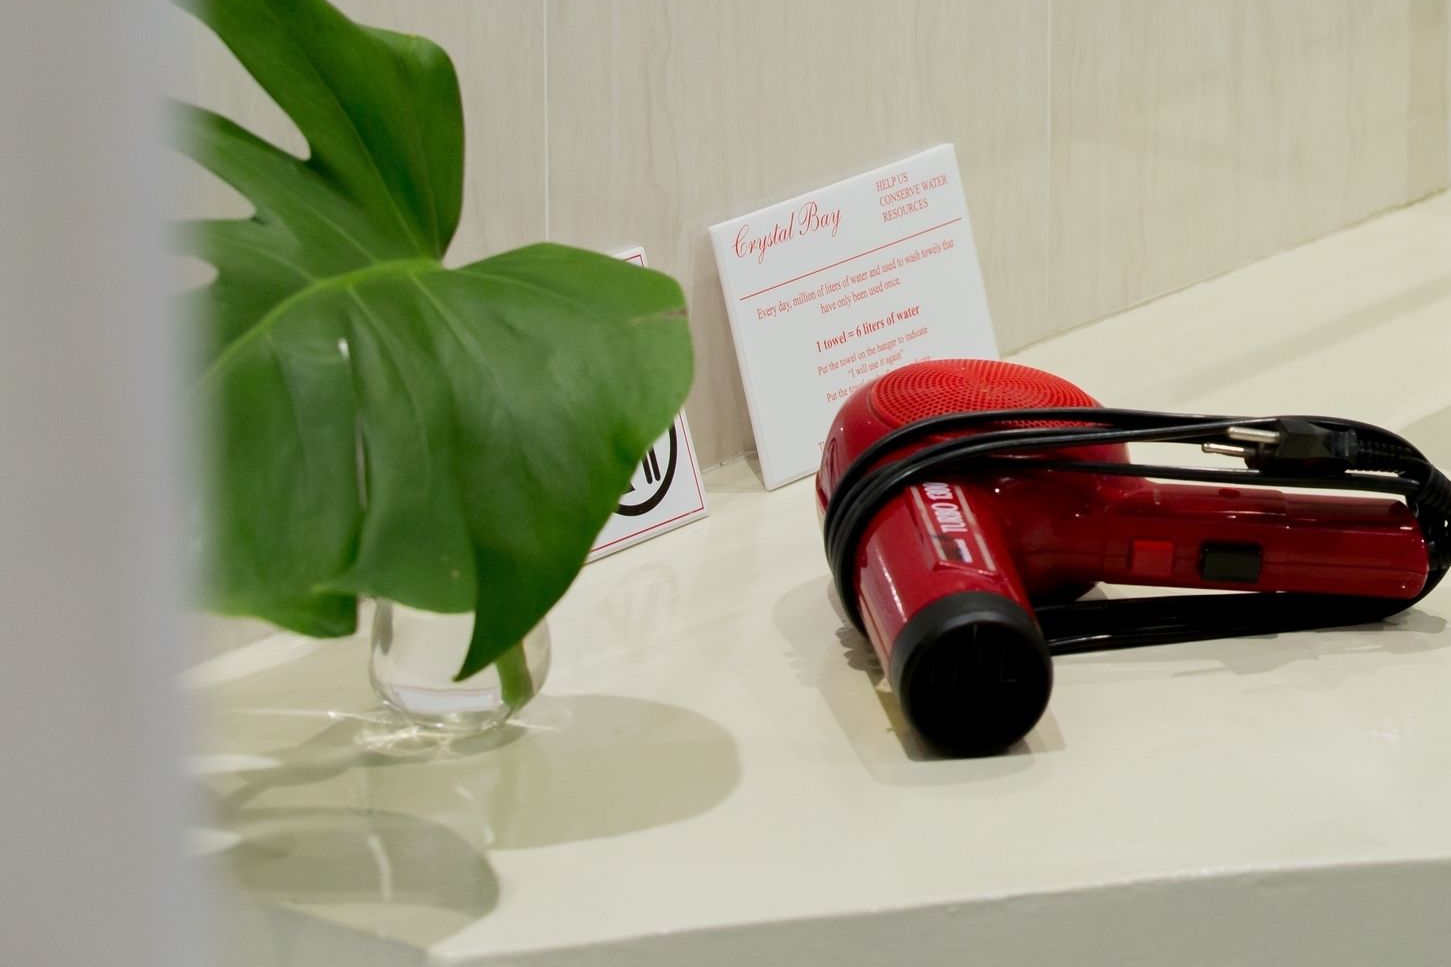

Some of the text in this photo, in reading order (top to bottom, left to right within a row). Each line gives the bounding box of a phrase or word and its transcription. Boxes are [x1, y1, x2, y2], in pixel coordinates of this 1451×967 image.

[876, 172, 908, 192] HELP US
[880, 175, 948, 207] CONSERVE WATER
[882, 198, 928, 223] RESOURCES
[732, 200, 841, 264] Crystal Bay
[757, 306, 777, 320] Every
[793, 290, 816, 307] million
[817, 284, 825, 297] of
[842, 275, 850, 288] of
[850, 271, 868, 284] water
[869, 264, 881, 278] and
[881, 258, 897, 273] used
[897, 258, 904, 268] to
[905, 250, 921, 264] wash
[820, 302, 836, 314] have
[837, 294, 851, 308] only
[852, 289, 867, 303] been
[868, 281, 883, 296] used
[816, 305, 920, 353] 1 towel = 6 liters of water
[817, 365, 829, 376] Put
[829, 360, 839, 372] the
[840, 352, 857, 367] towel
[866, 346, 877, 357] the
[898, 336, 905, 346] to
[868, 361, 879, 372] use
[826, 391, 838, 403] Put
[838, 387, 848, 399] the
